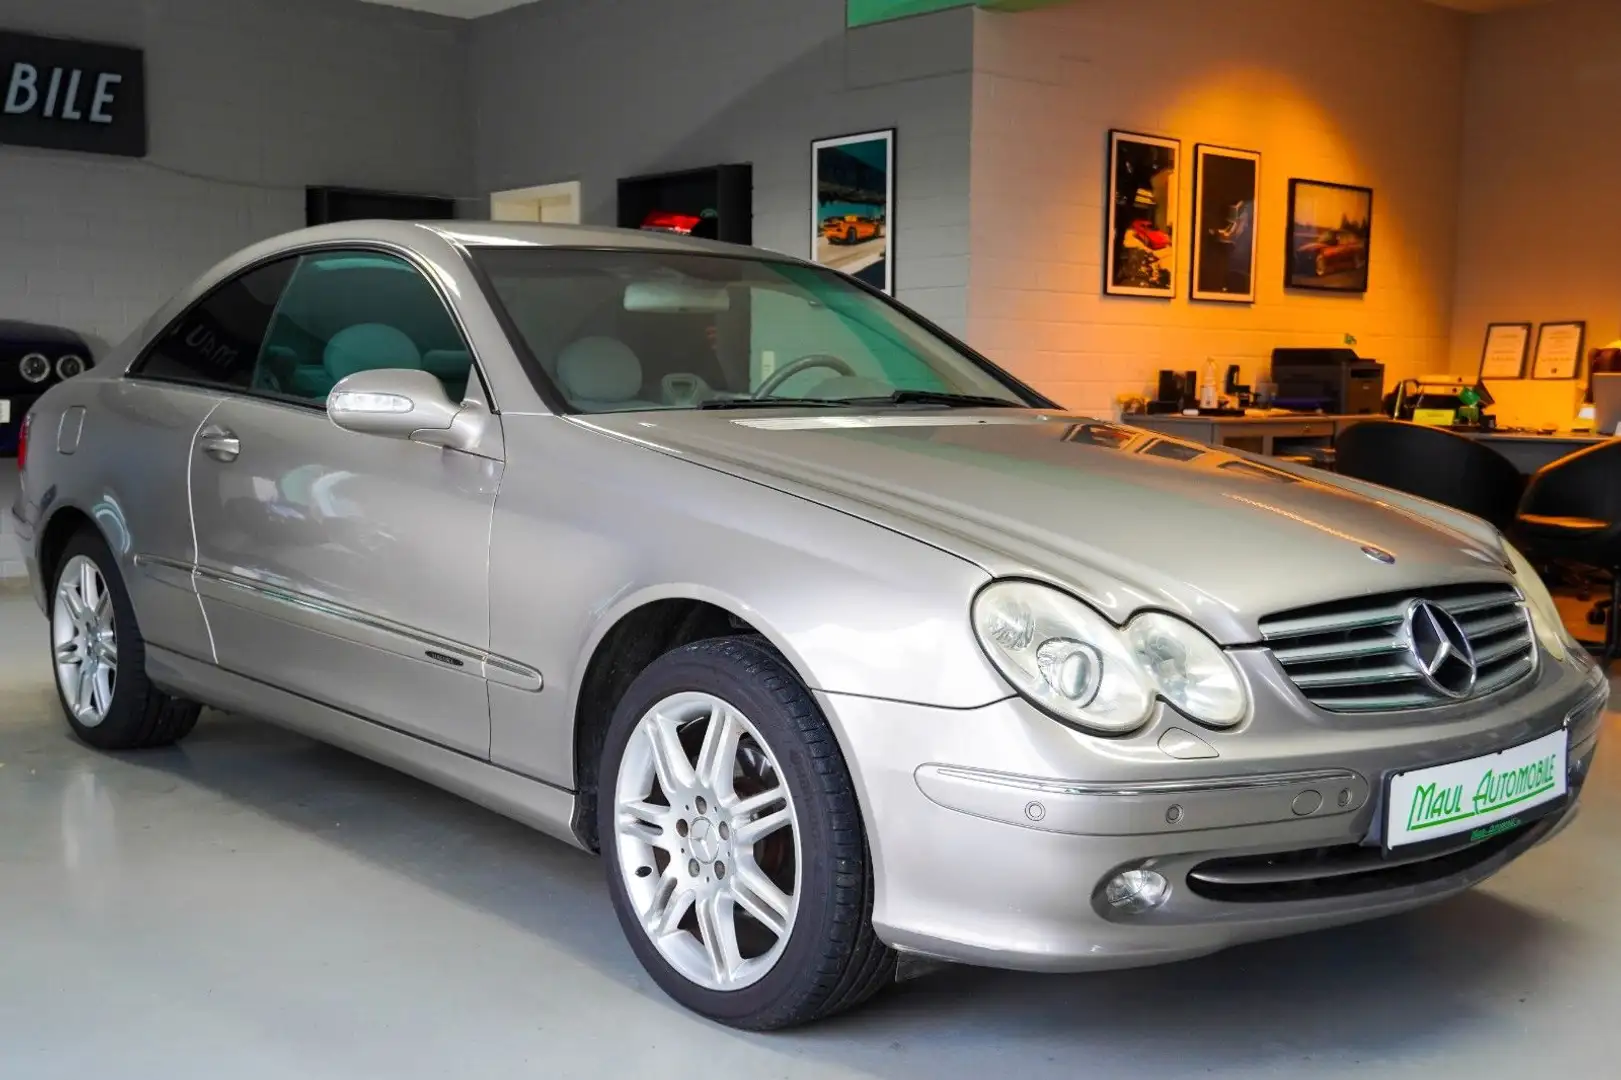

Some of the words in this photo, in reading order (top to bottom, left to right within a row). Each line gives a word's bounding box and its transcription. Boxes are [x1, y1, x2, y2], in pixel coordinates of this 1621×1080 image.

[4, 61, 122, 124] BILE
[1406, 782, 1464, 831] MAUL
[1472, 753, 1557, 814] AUTOMOBILE
